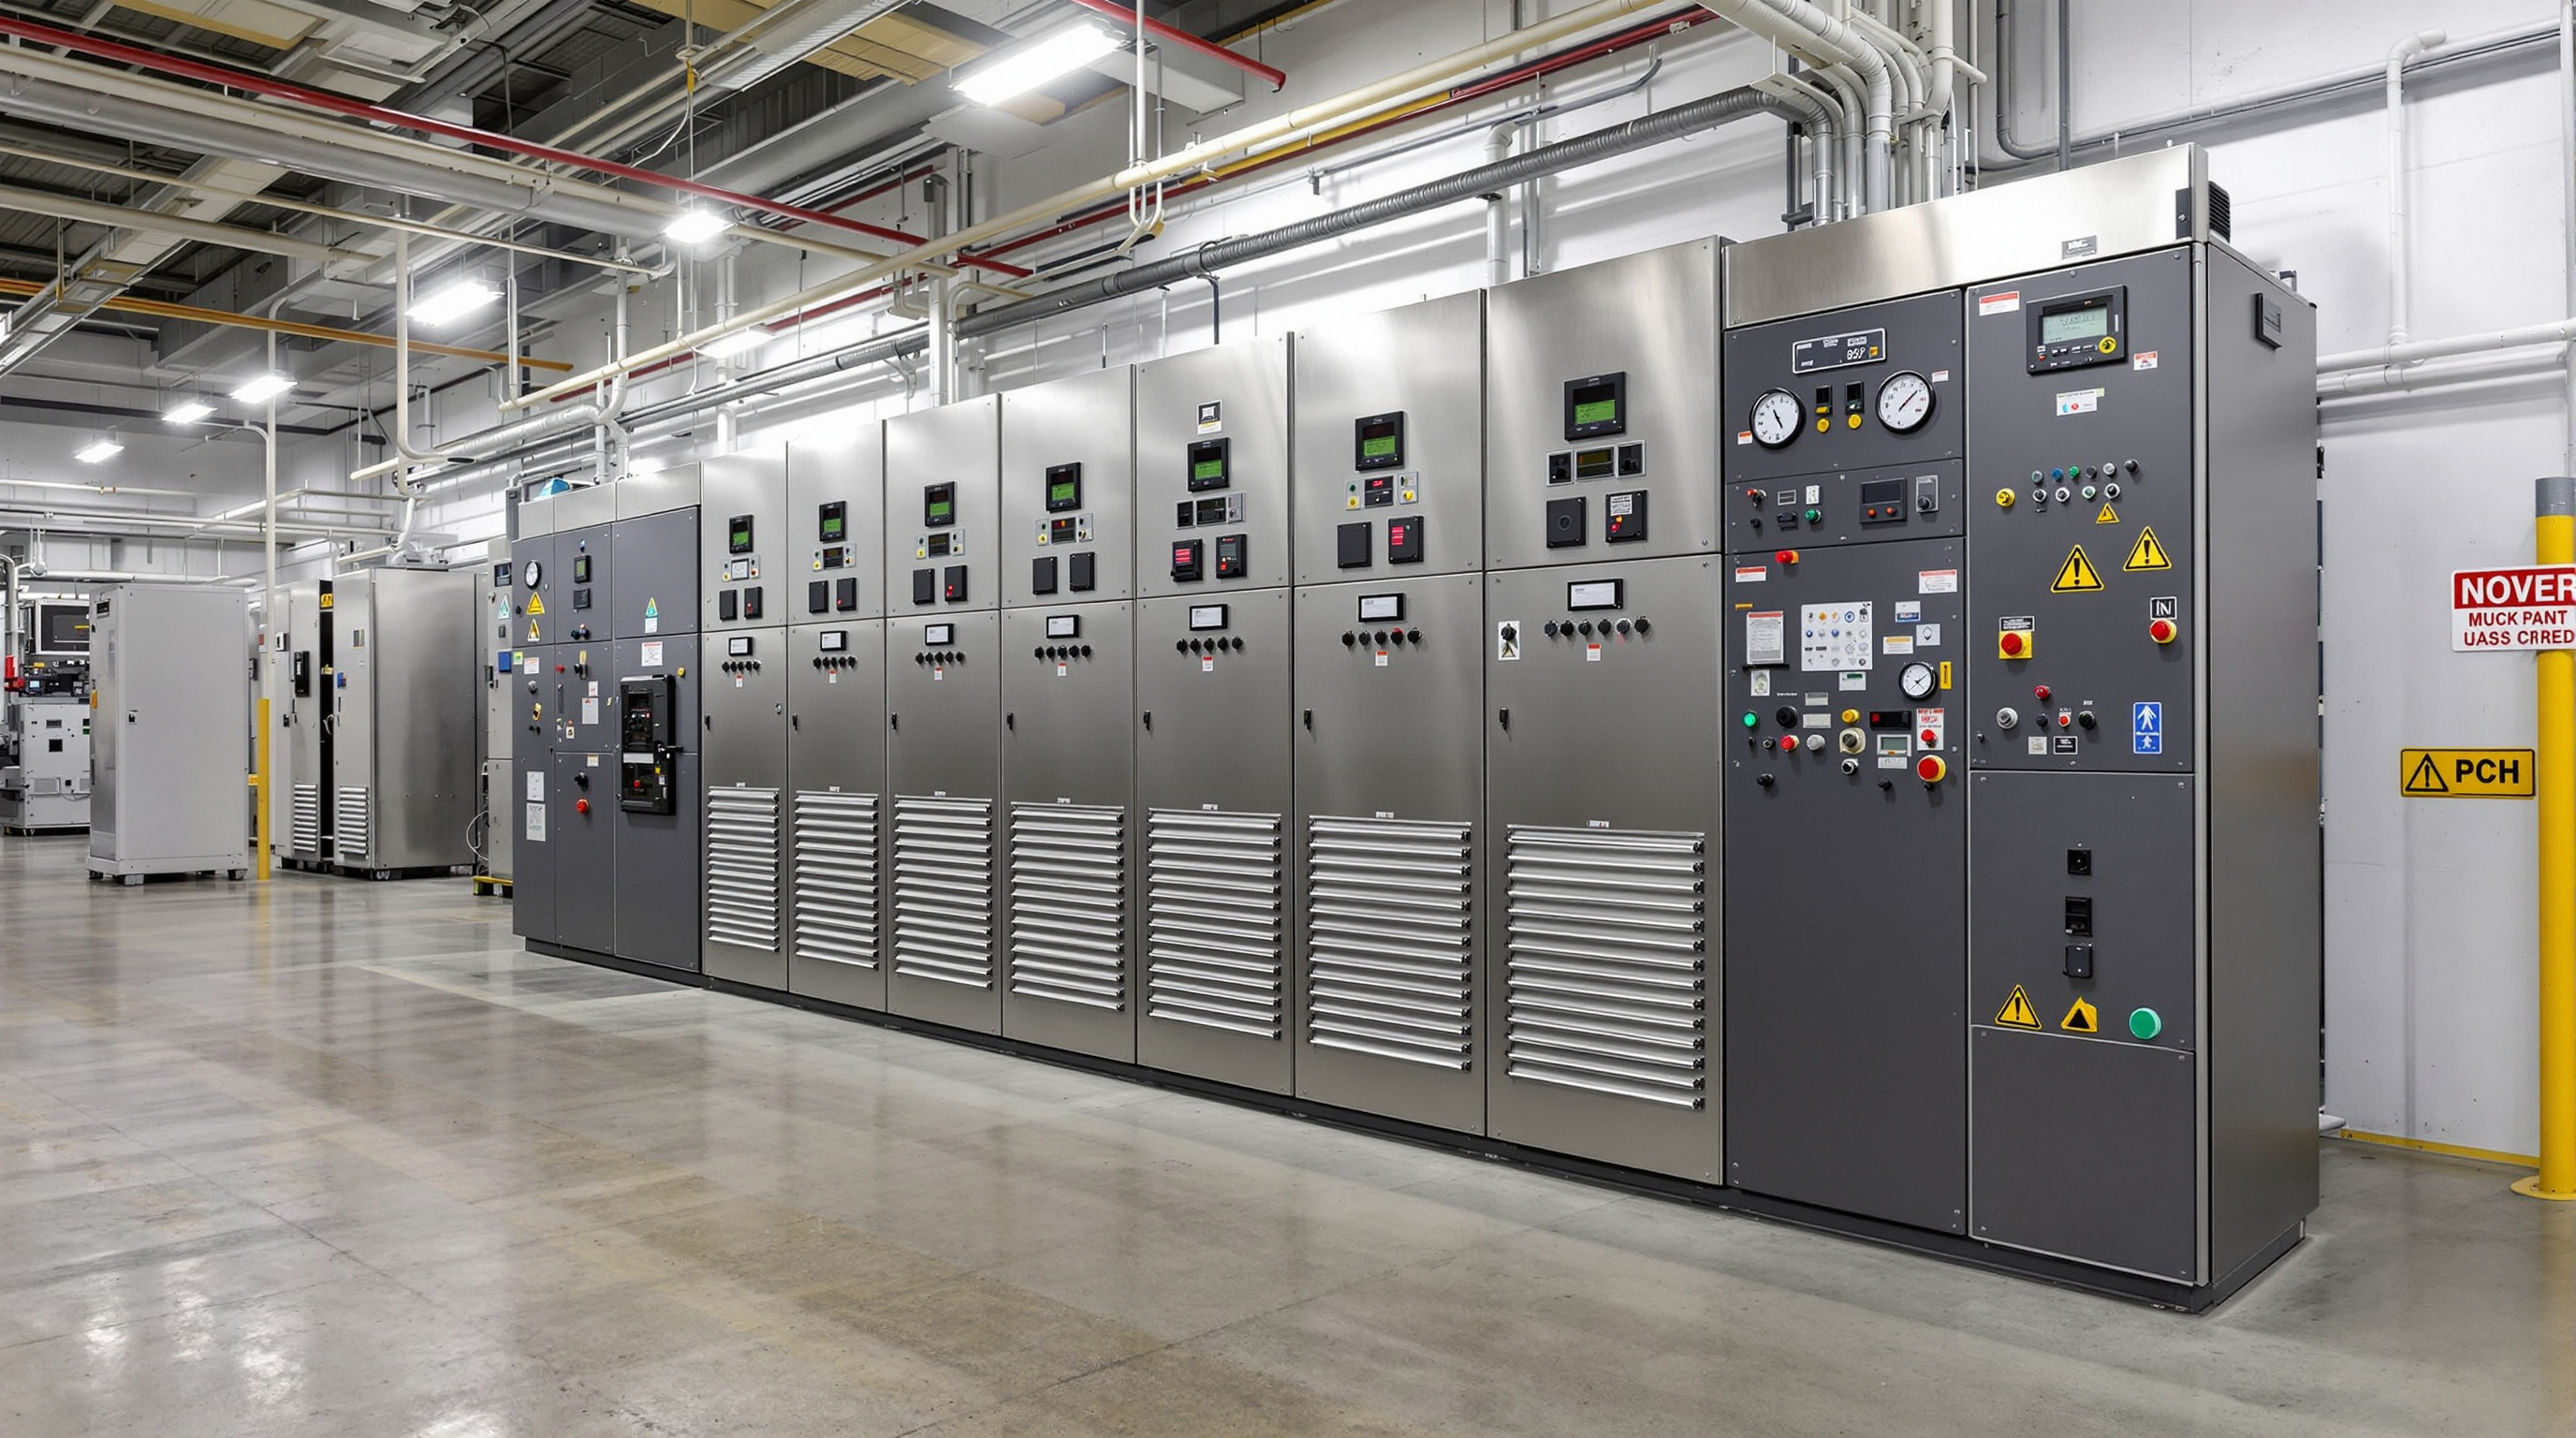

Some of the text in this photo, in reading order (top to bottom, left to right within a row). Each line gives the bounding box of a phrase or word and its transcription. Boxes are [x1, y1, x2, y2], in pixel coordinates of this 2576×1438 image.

[2468, 609, 2568, 626] MUCK PANT
[2464, 630, 2510, 646] UASS
[2455, 758, 2520, 784] PCH
